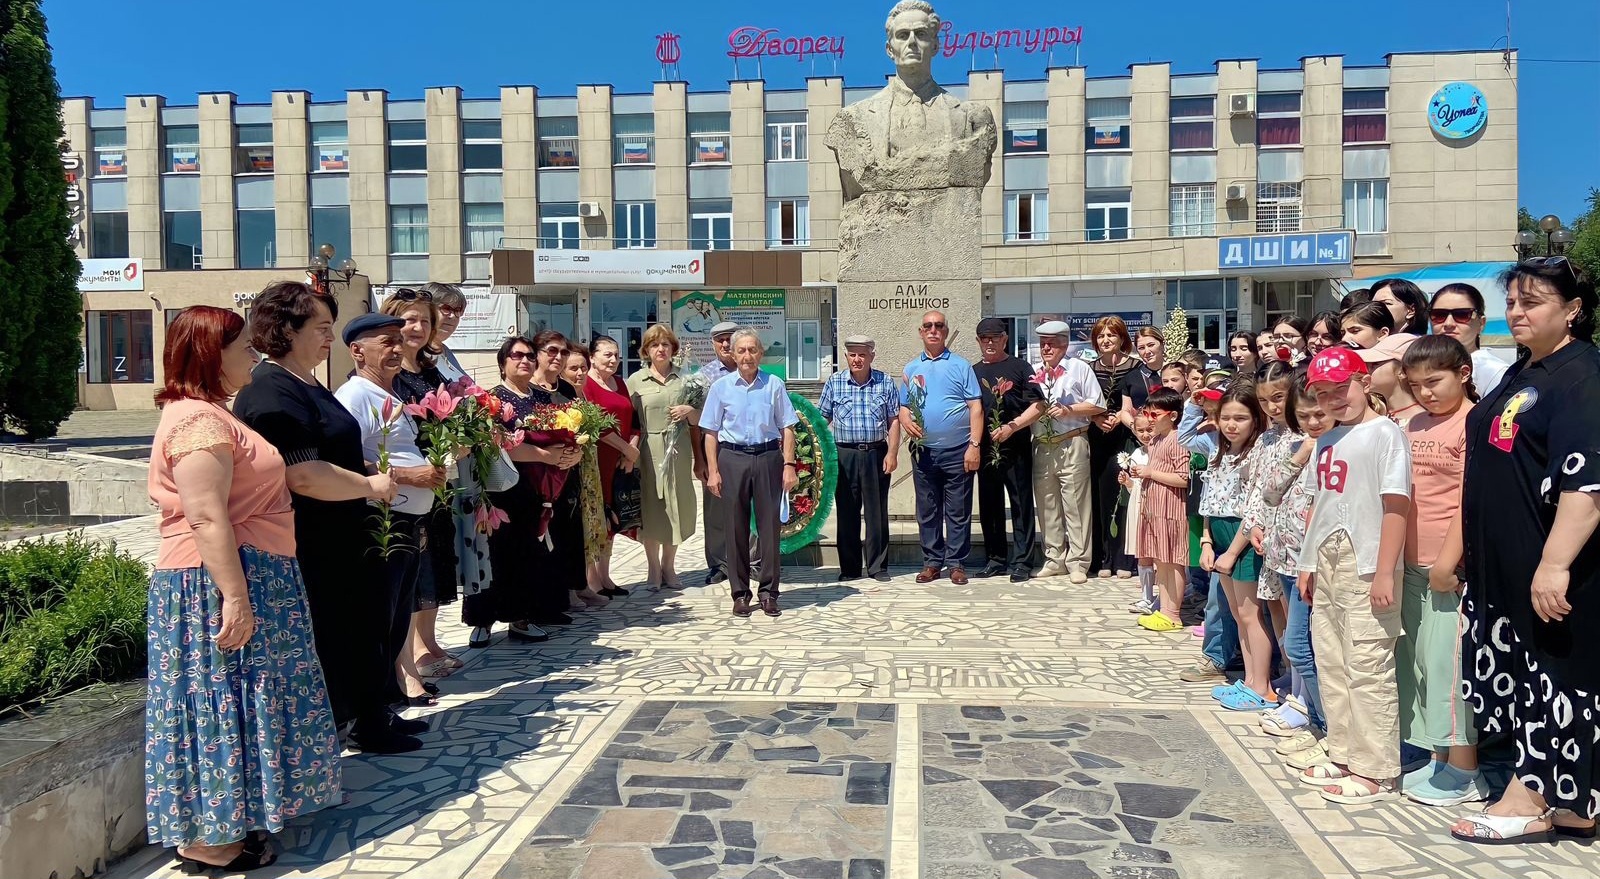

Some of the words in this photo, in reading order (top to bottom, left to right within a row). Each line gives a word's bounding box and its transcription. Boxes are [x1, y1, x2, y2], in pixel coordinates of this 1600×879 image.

[727, 26, 845, 62] Дворец
[1438, 104, 1478, 127] Успех
[1224, 239, 1309, 264] ДШИ
[895, 284, 928, 296] АЛИ
[869, 298, 950, 309] ШОГЕНЦУКОВ
[114, 356, 127, 372] Z
[1411, 440, 1446, 454] ERRY
